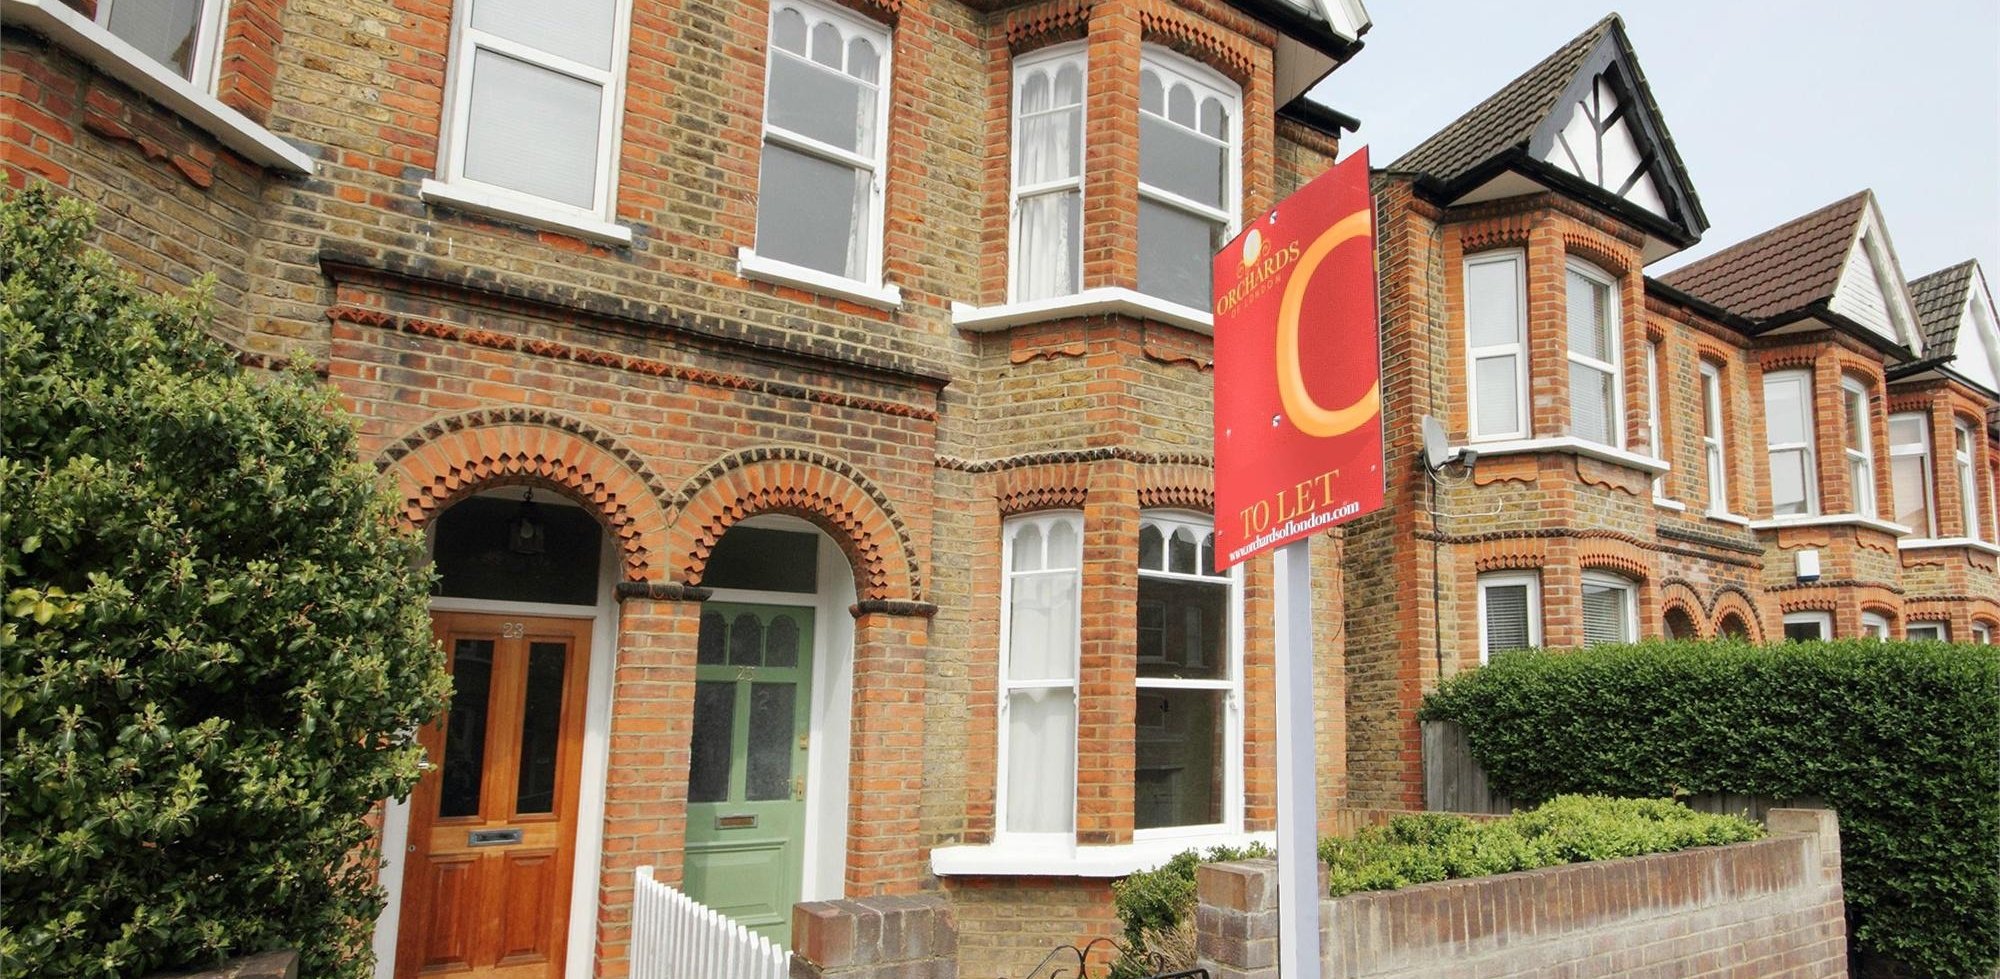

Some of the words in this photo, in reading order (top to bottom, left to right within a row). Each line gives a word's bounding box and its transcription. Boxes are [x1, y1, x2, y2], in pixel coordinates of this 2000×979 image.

[1217, 240, 1300, 316] ORCHARDS
[1228, 501, 1360, 562] www.orchardsoflondon.com
[1240, 500, 1270, 539] TO
[1276, 468, 1340, 523] LET
[503, 622, 524, 639] 23
